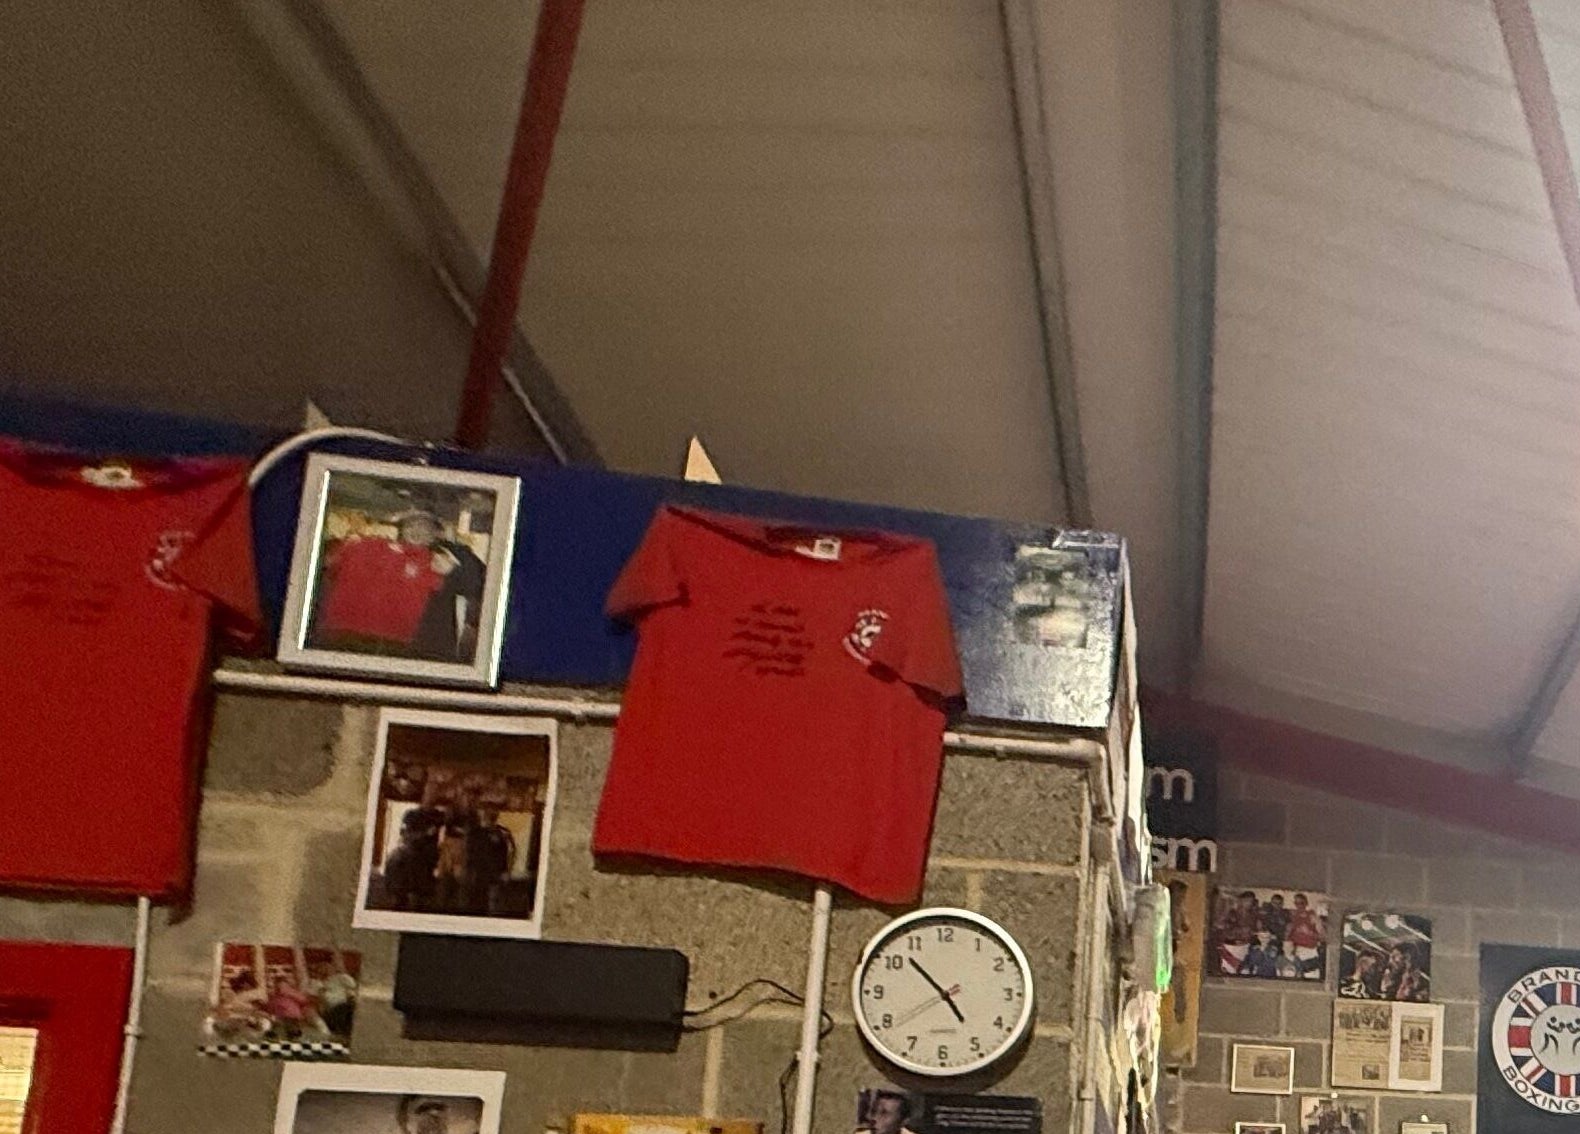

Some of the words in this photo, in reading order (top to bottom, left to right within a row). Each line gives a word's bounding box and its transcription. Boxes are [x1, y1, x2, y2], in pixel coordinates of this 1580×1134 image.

[908, 935, 922, 951] 11
[936, 927, 954, 943] 12
[975, 937, 982, 952] 1
[885, 954, 903, 971] 10
[993, 957, 1005, 972] 2
[873, 985, 884, 1000] 9
[1003, 987, 1014, 1002] 3
[882, 1013, 893, 1029] 8
[993, 1015, 1003, 1031] 4
[907, 1035, 918, 1051] 7
[970, 1037, 981, 1052] 5
[938, 1044, 948, 1060] 6
[1502, 1064, 1580, 1112] BOXING
